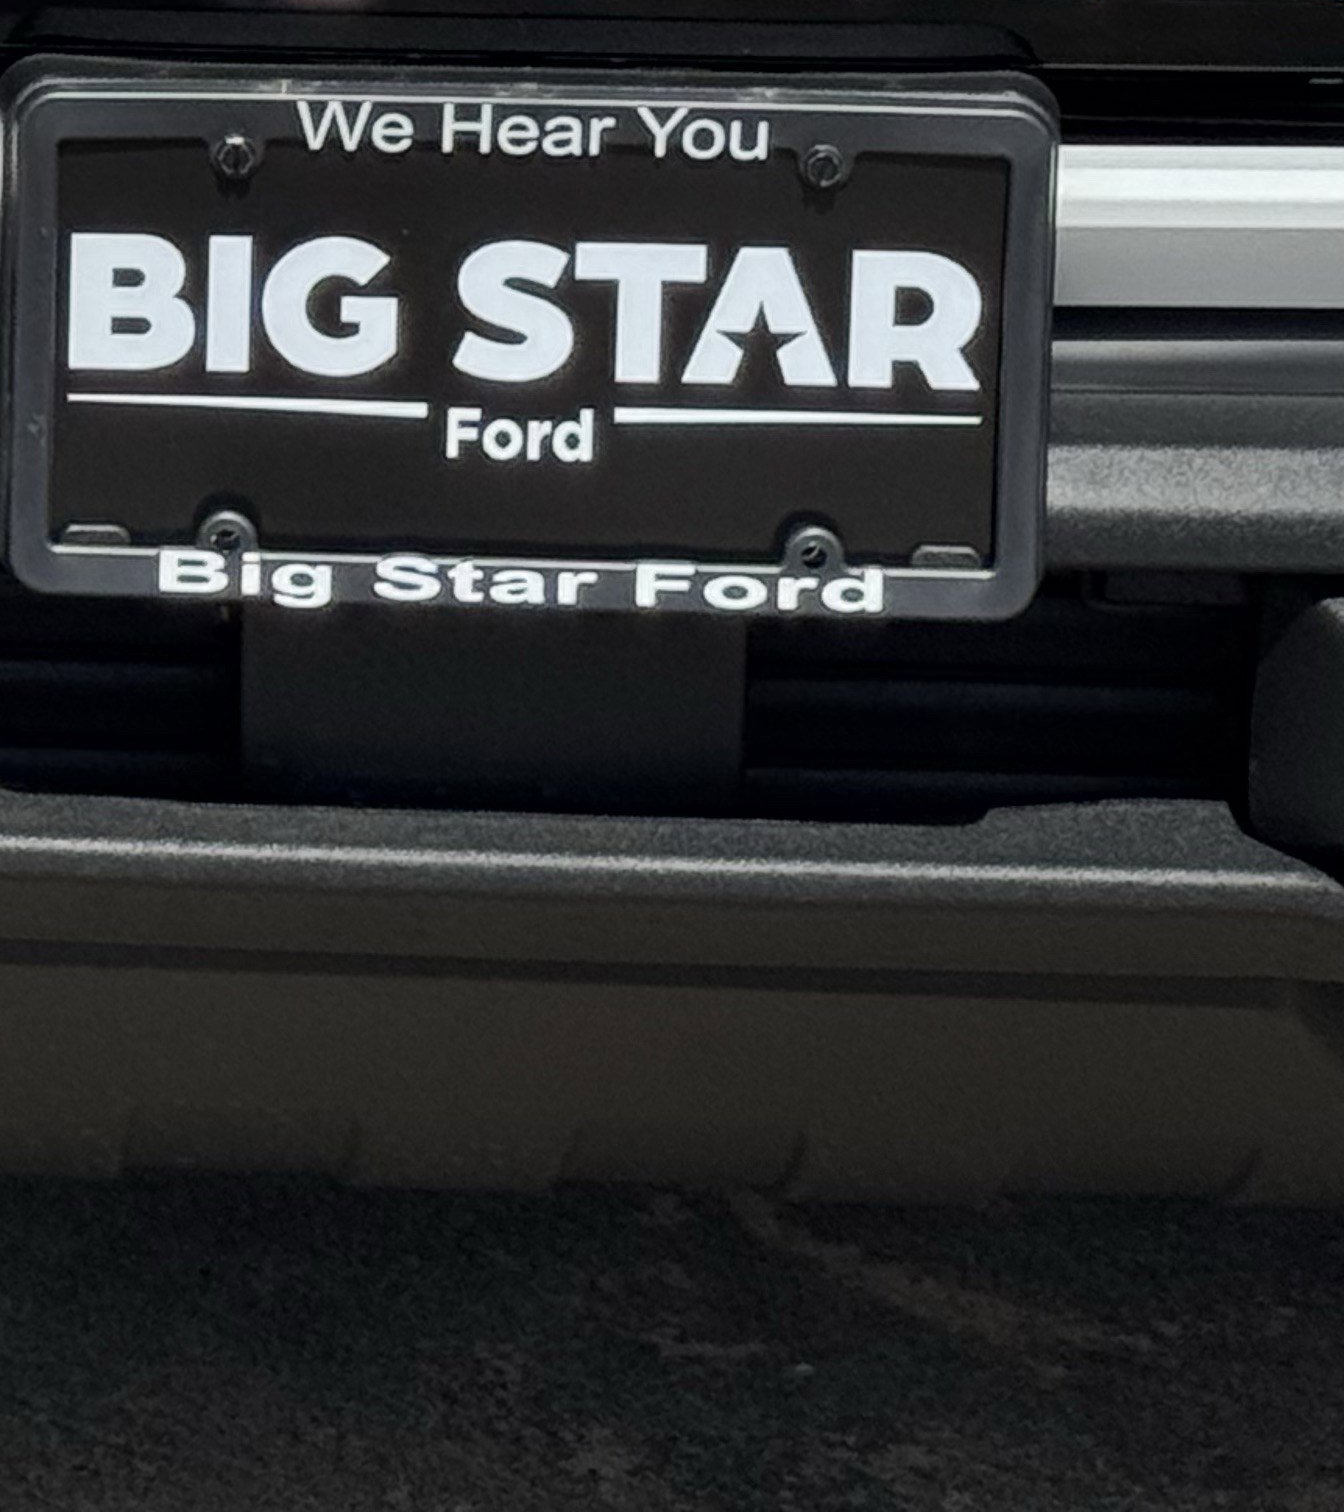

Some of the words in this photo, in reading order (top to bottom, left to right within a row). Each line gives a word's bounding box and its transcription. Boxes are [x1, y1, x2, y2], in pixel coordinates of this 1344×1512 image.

[296, 100, 414, 154] We
[441, 102, 616, 157] Hear
[637, 106, 769, 161] You
[67, 232, 399, 377] BIG
[452, 241, 983, 392] STAR
[444, 406, 595, 464] Ford
[157, 548, 333, 609] Big
[371, 553, 598, 607] Star
[633, 561, 885, 614] Ford
